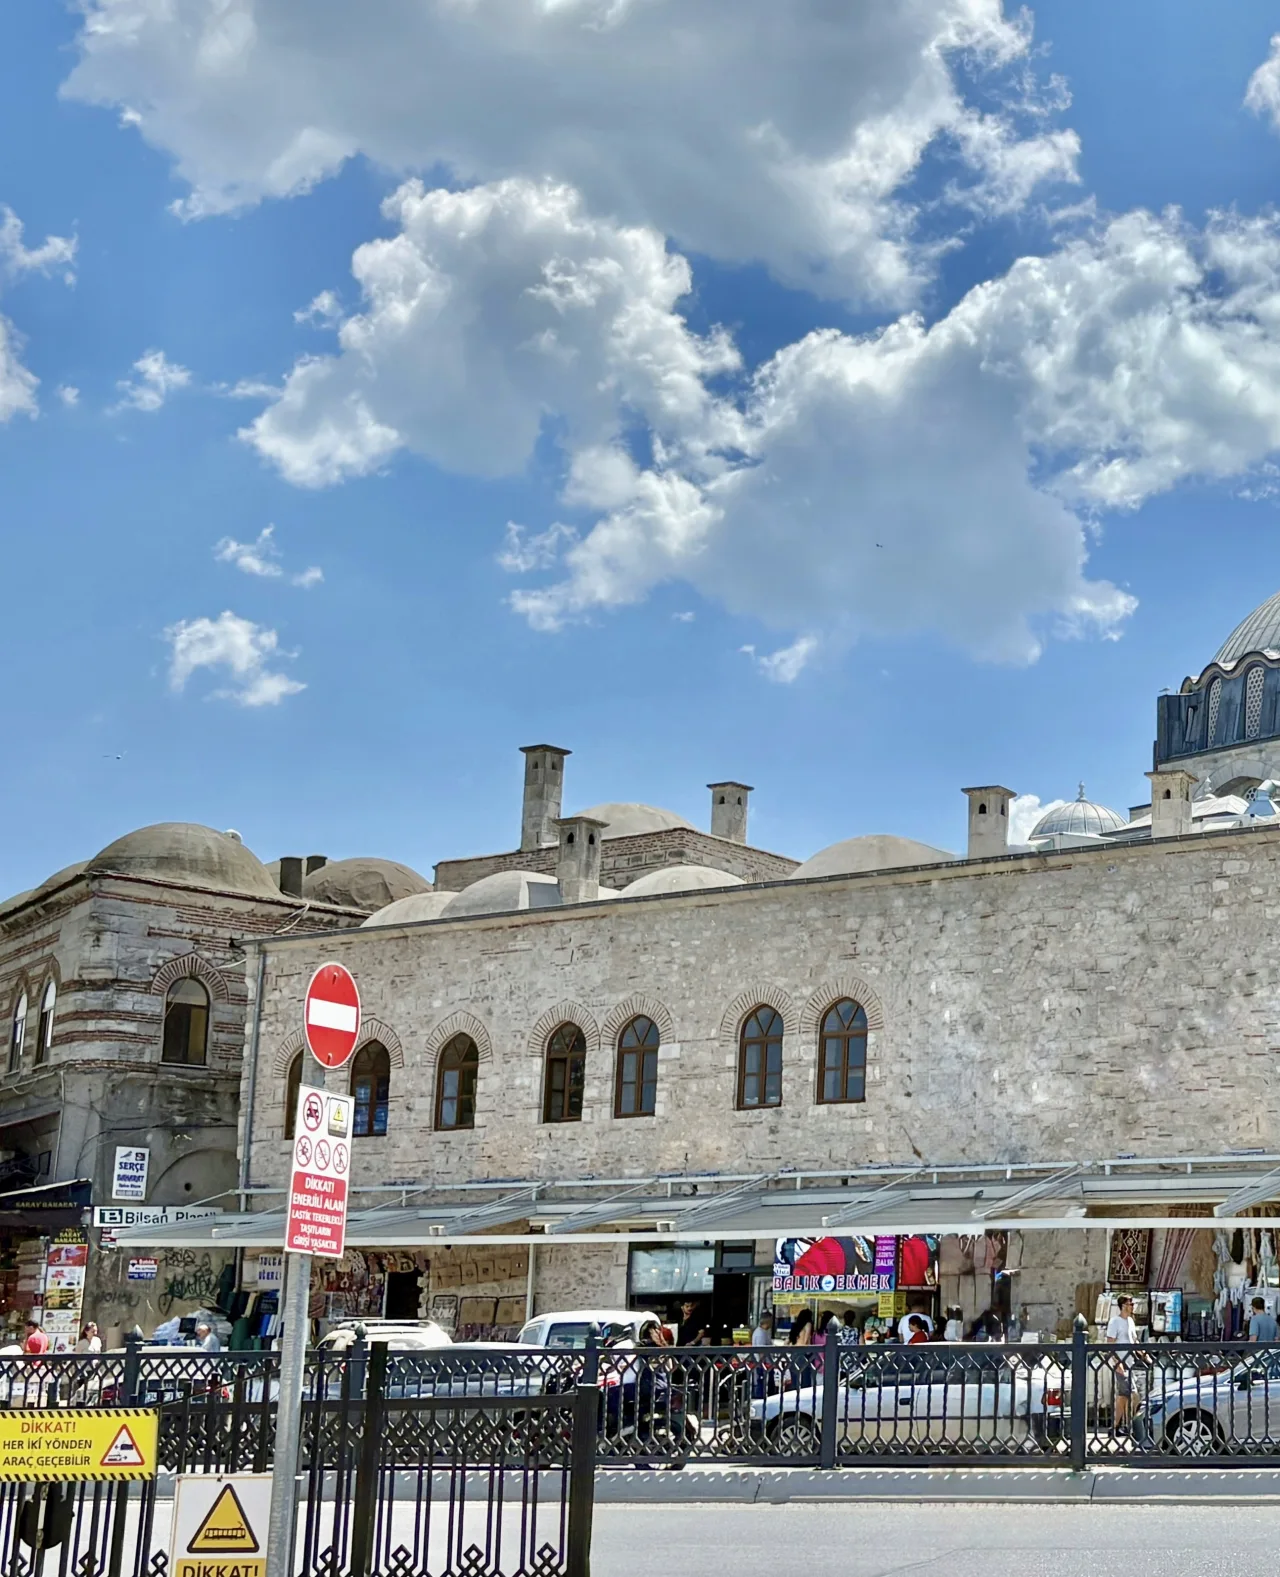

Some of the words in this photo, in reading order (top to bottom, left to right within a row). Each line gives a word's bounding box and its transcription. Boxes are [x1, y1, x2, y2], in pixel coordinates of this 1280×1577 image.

[119, 1162, 145, 1173] SERÇE
[292, 1193, 323, 1208] ENERJİLİ
[324, 1198, 344, 1212] ALAN
[125, 1211, 168, 1224] Bilsan
[292, 1209, 312, 1221] LASTİK
[312, 1212, 343, 1225] TEKERLEKLİ
[875, 1258, 894, 1267] BALIK
[772, 1275, 820, 1290] BALIK
[836, 1274, 891, 1290] EKMEK
[21, 1420, 76, 1433] DİKKAT!
[3, 1440, 24, 1449] HER
[28, 1437, 42, 1449] İKİ
[45, 1437, 92, 1449] YÖNDEN
[3, 1456, 34, 1468] ARAÇ
[36, 1455, 91, 1468] GEÇEBİLİR
[183, 1561, 259, 1577] DİKKAT!
